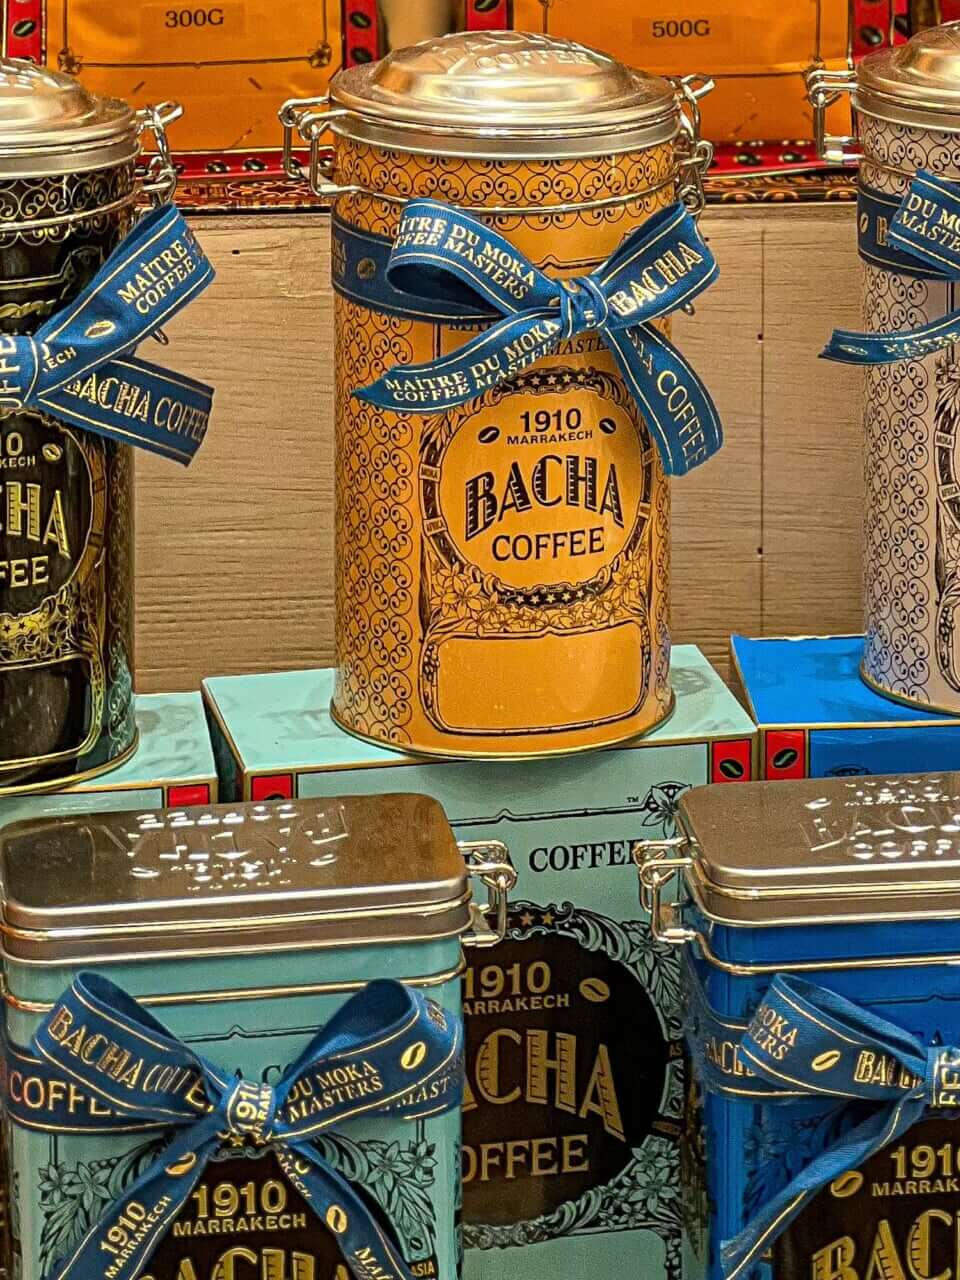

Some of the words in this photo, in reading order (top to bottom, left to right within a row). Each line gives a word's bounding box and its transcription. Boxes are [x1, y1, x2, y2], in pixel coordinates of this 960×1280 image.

[165, 9, 225, 28] 300G
[652, 19, 711, 38] 500G
[906, 192, 938, 219] DU
[445, 239, 528, 299] MASTERS
[450, 226, 480, 247] DU
[482, 242, 536, 286] MOKA
[136, 256, 196, 314] COFFEE
[608, 241, 703, 316] BACHA
[469, 352, 500, 378] DU
[502, 320, 561, 364] MOKA
[393, 383, 471, 402] COFFEE
[506, 430, 593, 445] MARRAKECH
[519, 407, 582, 433] 1910
[464, 454, 625, 541] BACHA
[491, 526, 605, 561] COFFEE
[463, 993, 569, 1016] ARRAKECH
[48, 1004, 144, 1089] BACHA
[317, 1061, 378, 1092] MOKA
[290, 1075, 384, 1123] MASTERS
[463, 1133, 590, 1183] OFFEE
[192, 1180, 287, 1218] 1910
[101, 1201, 146, 1255] 1910
[104, 1195, 172, 1280] MARRAKECH
[172, 1213, 307, 1237] MARRAKECH
